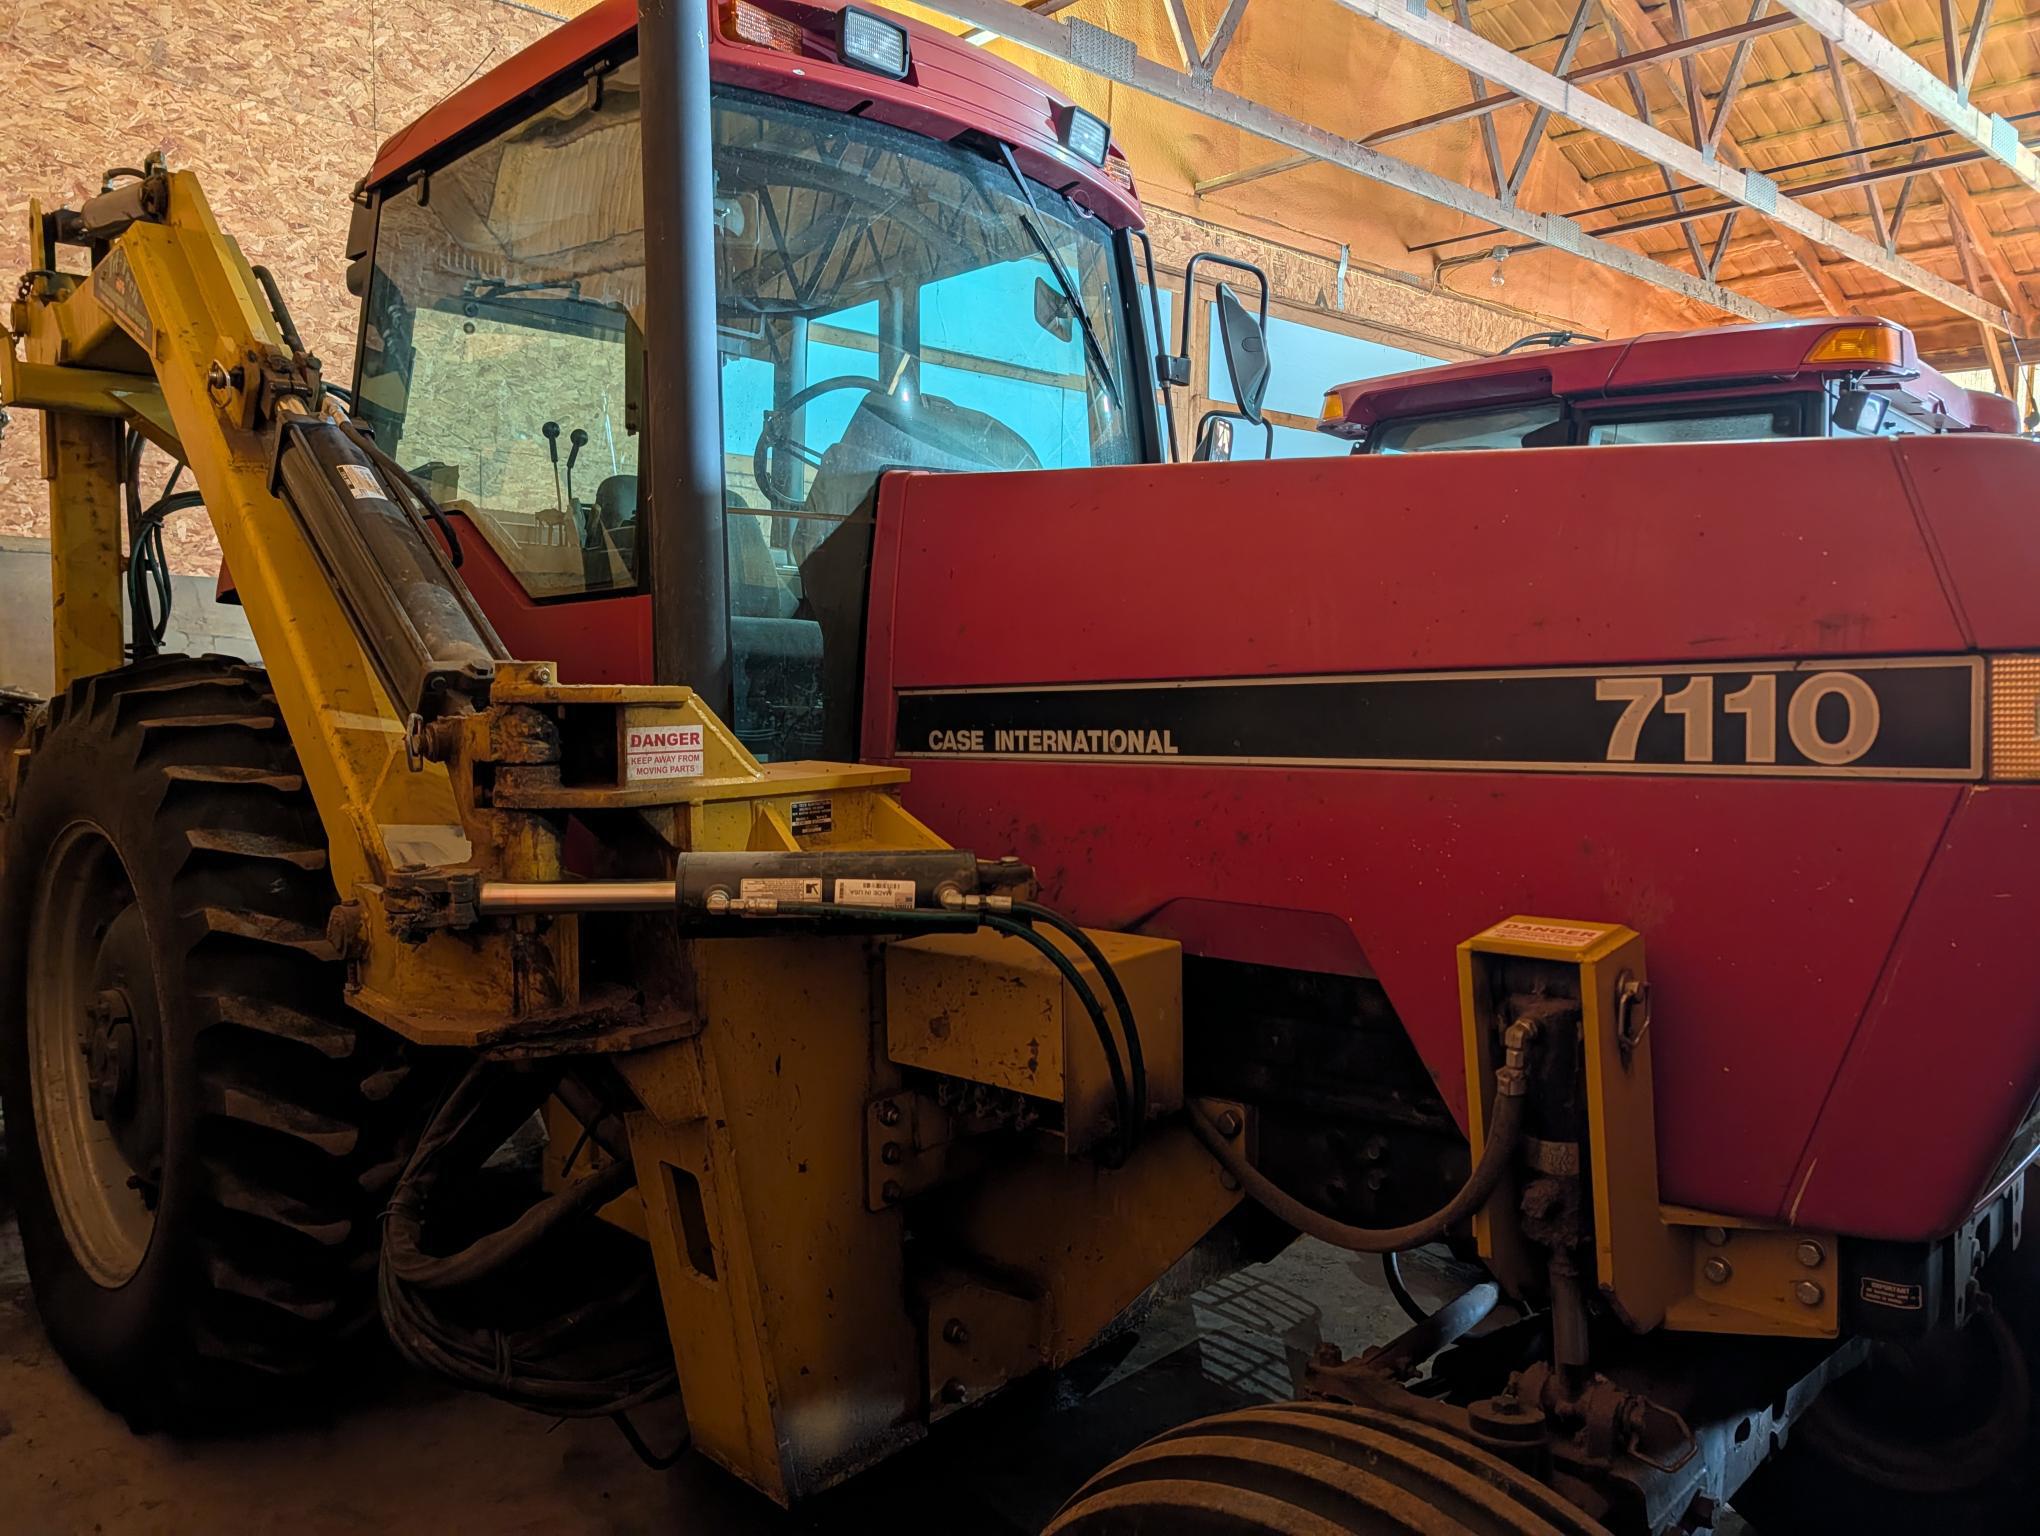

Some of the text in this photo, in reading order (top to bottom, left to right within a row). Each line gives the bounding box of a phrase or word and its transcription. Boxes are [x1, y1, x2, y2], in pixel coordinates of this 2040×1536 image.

[1595, 671, 1880, 765] 7110
[630, 732, 700, 748] DANGER
[928, 729, 1179, 754] CASE INTERNATIONAL
[631, 754, 700, 765] KEEP AWAY FROM
[636, 765, 695, 775] MOVING PARTS
[1503, 923, 1597, 937] DANGER
